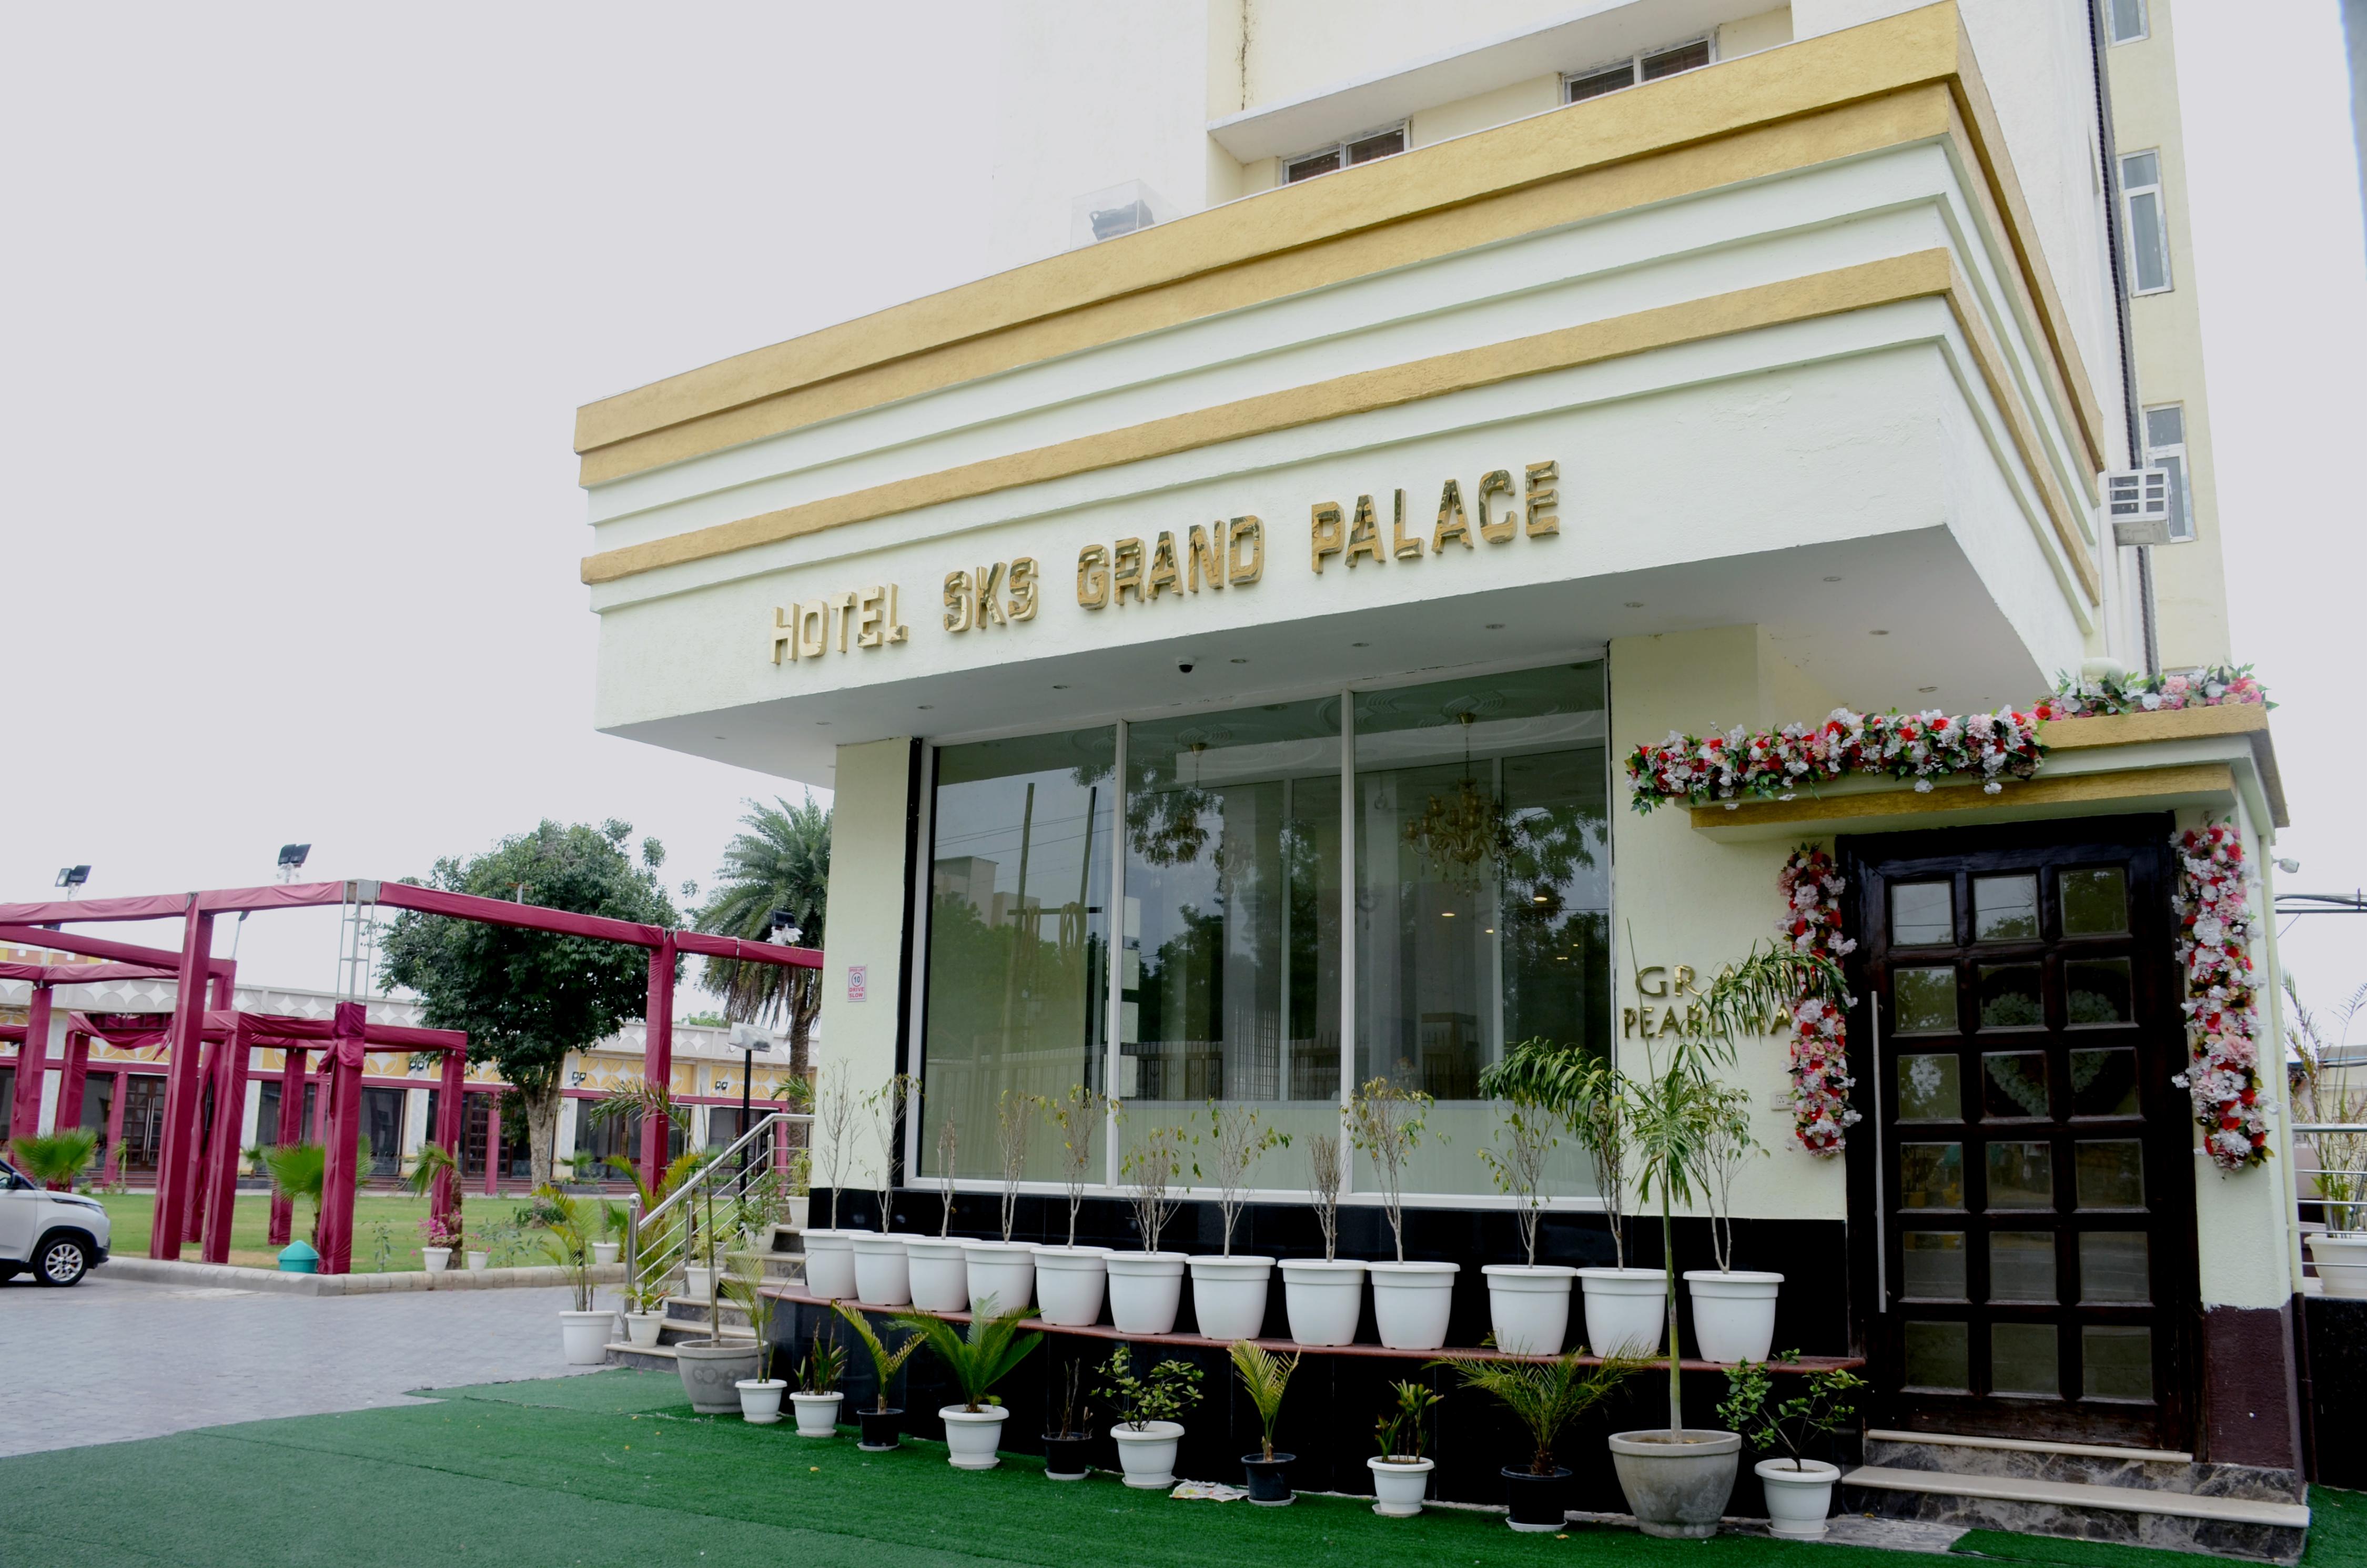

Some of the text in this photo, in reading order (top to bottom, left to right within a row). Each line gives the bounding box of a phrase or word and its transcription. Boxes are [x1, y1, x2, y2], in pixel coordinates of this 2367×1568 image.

[770, 460, 1560, 664] HOTEL SKS GRAND PALACE
